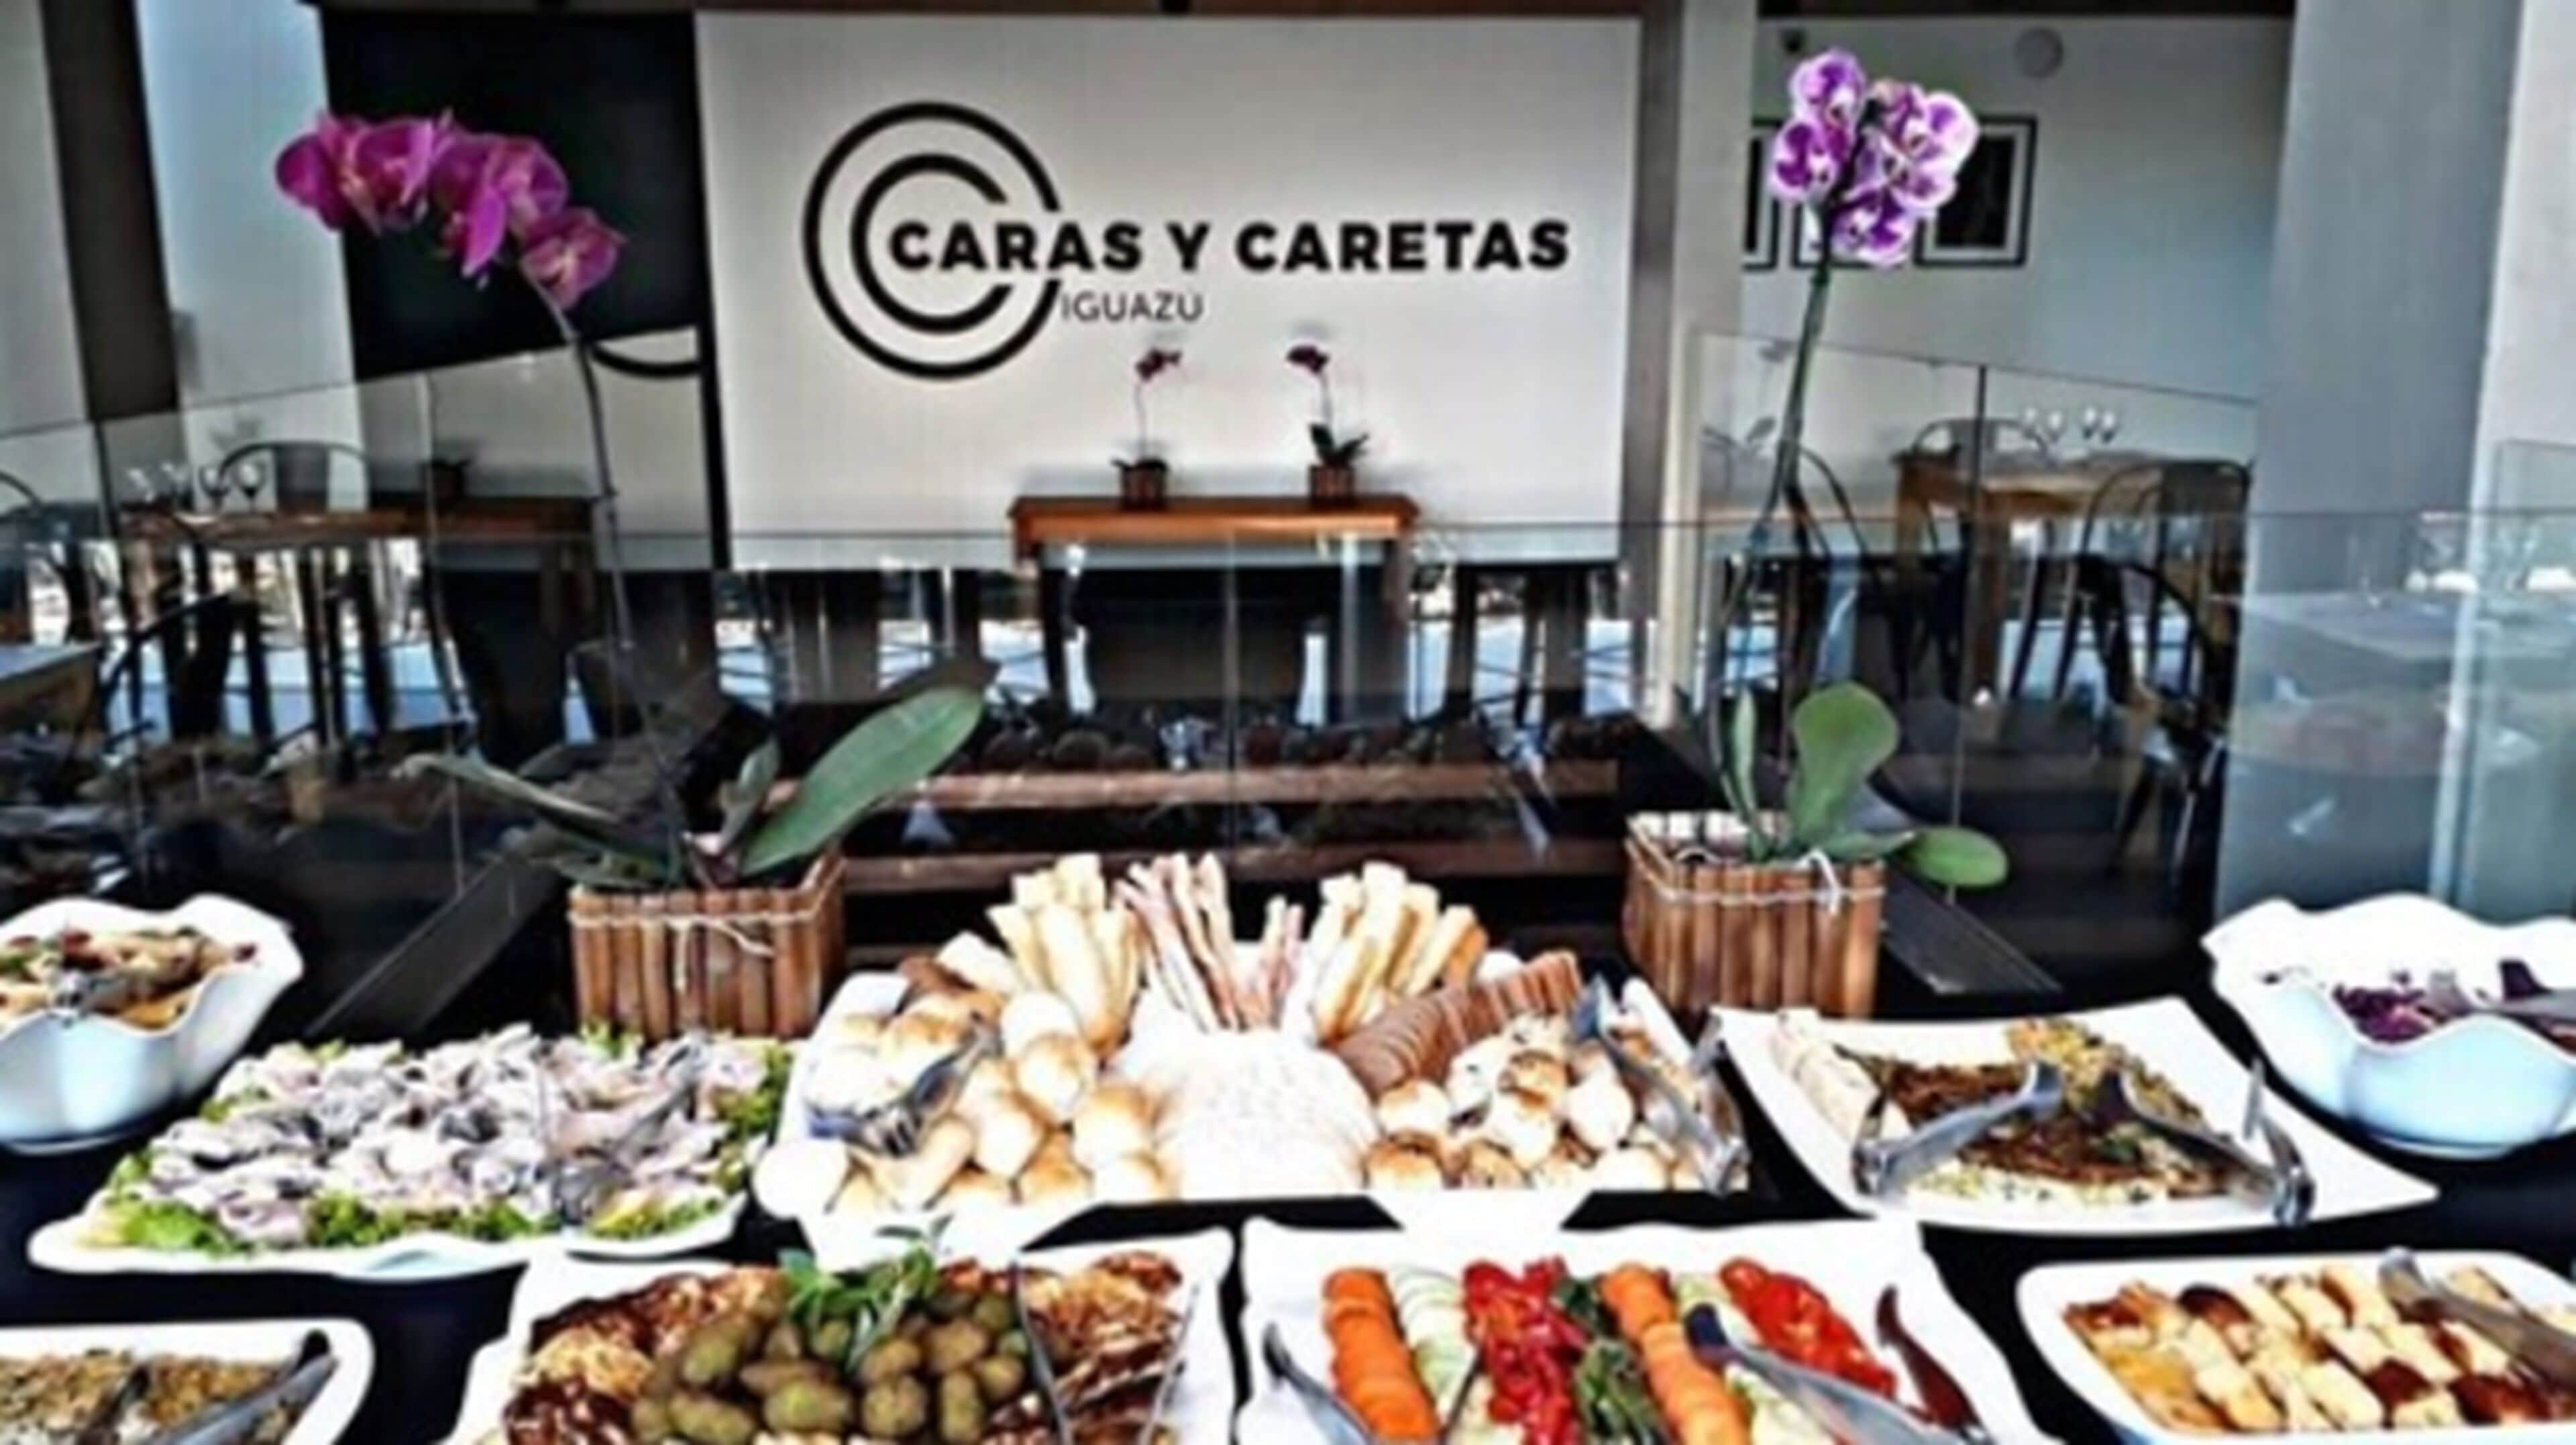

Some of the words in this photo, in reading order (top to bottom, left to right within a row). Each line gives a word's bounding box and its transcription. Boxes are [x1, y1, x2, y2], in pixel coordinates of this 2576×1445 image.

[888, 220, 1143, 272] CARAS
[1166, 222, 1211, 272] Y
[1235, 220, 1569, 272] CARETAS
